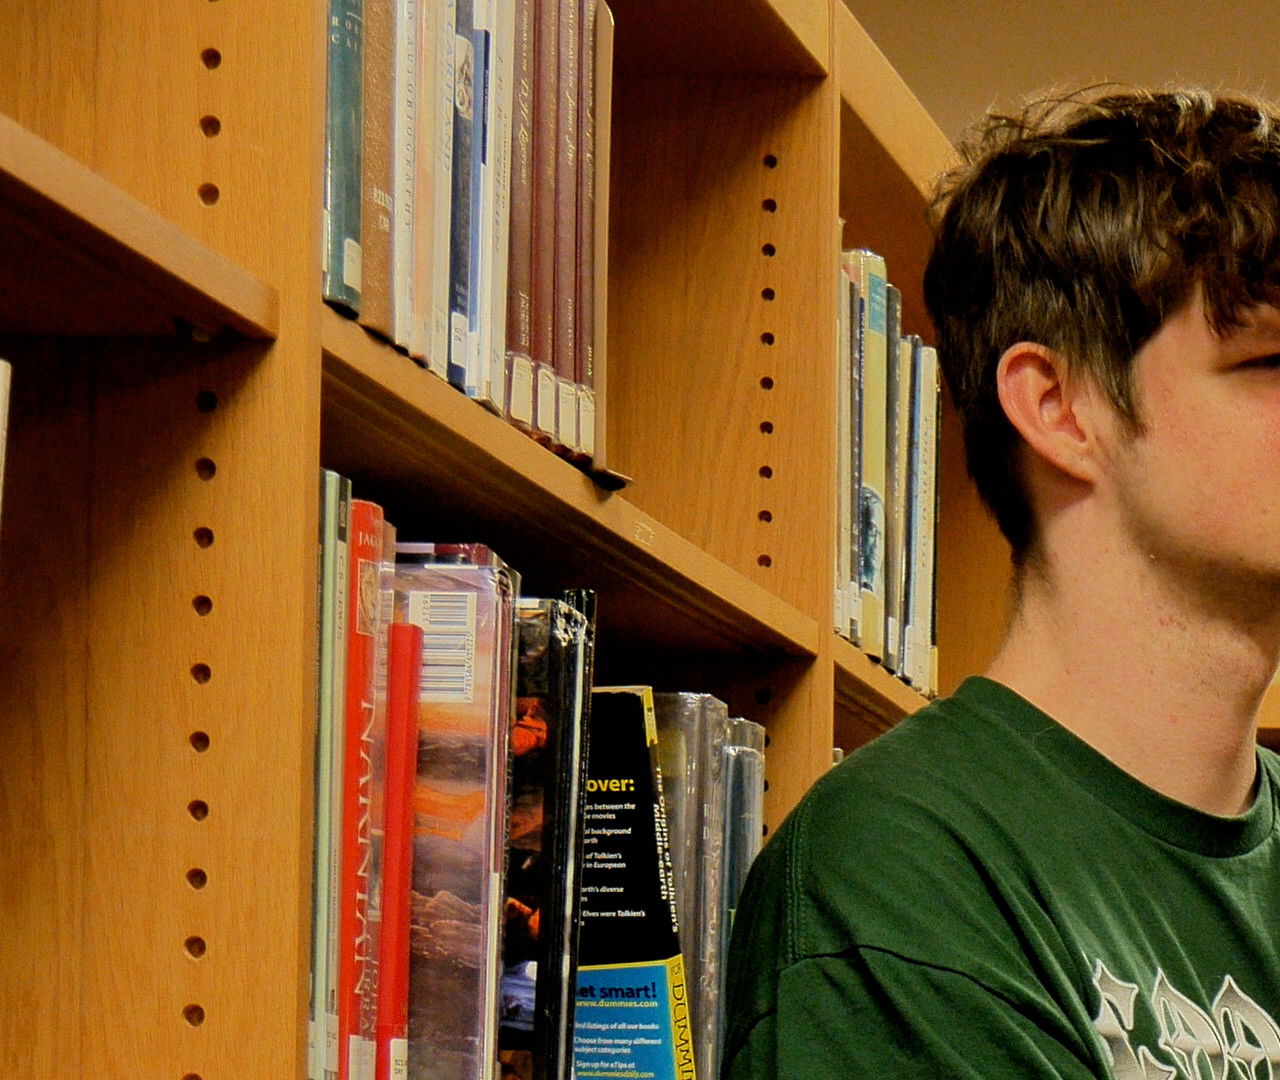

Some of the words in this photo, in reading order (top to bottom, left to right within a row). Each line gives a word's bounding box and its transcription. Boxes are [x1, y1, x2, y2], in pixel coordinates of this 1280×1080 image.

[403, 38, 415, 231] AUTOBIOGRAPHY
[590, 803, 622, 811] between
[591, 812, 616, 820] movies
[591, 827, 632, 837] background
[354, 698, 377, 996] NARNIAN
[653, 803, 669, 900] Middle-earth
[594, 852, 622, 861] Tolkien's
[593, 861, 626, 871] European
[599, 886, 624, 894] diverse
[617, 909, 646, 918] Tolkien's
[599, 981, 657, 999] smart!
[575, 999, 659, 1009] www.dummies.com
[574, 1037, 597, 1045] Choose
[633, 1037, 662, 1046] different
